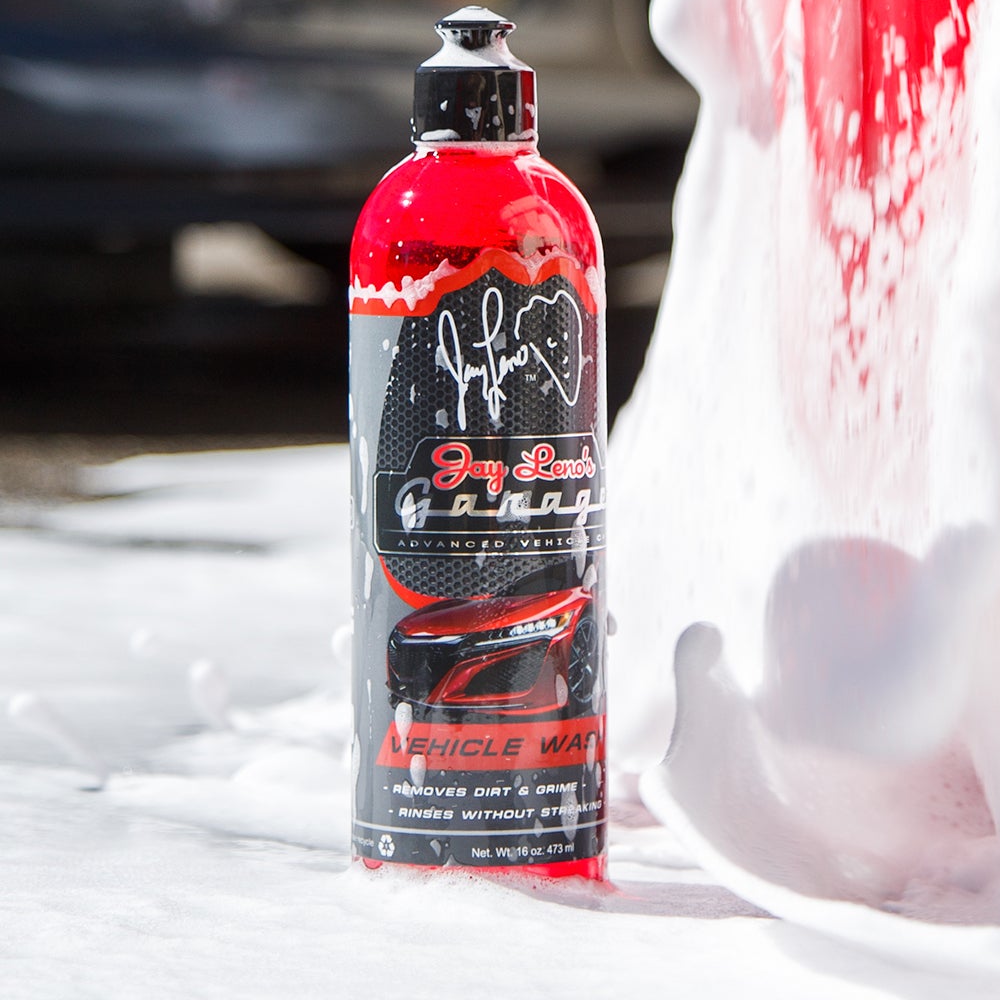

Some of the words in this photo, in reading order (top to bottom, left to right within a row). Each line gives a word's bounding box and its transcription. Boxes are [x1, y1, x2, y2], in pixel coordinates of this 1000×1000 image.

[525, 374, 537, 382] TM
[431, 442, 509, 494] Jay
[513, 442, 597, 481] Leno's
[397, 539, 505, 549] ADVANCED
[519, 535, 590, 548] VEHICE
[391, 735, 525, 757] VEHICLE
[392, 784, 467, 797] REMOVES
[474, 786, 512, 798] DIRT
[517, 785, 529, 796] &
[535, 781, 578, 795] GRIME
[398, 807, 454, 820] RINSES
[462, 808, 535, 820] WITHOUT
[471, 847, 493, 859] Net.
[495, 846, 514, 858] Wt.
[516, 845, 529, 857] 16
[546, 843, 563, 855] 473
[564, 842, 575, 853] ml
